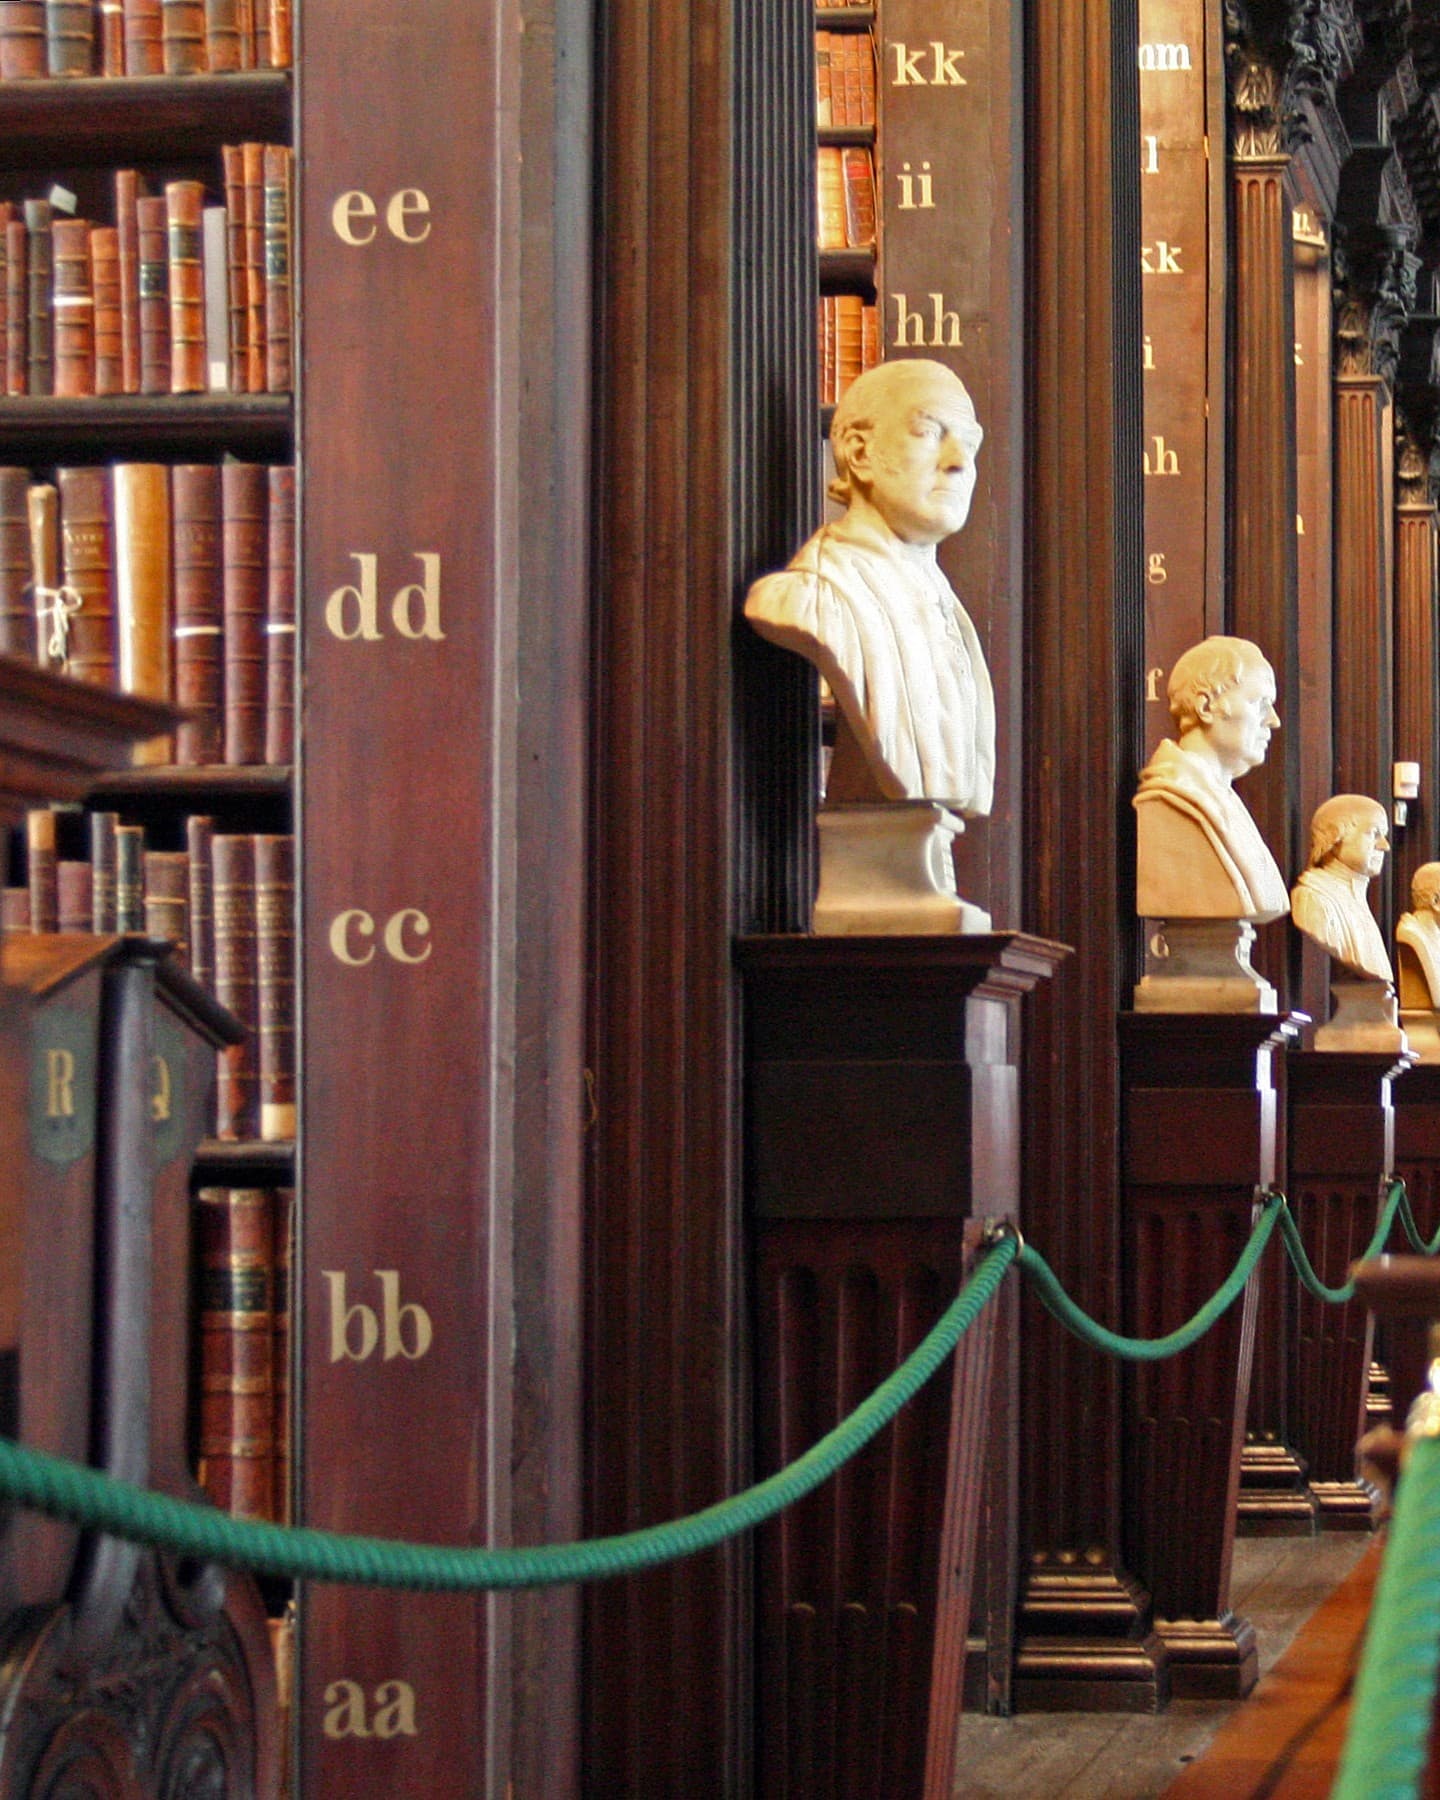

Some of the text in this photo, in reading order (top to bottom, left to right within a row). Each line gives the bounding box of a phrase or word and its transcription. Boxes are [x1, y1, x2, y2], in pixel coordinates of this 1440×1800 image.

[891, 41, 967, 86] kk
[896, 160, 936, 209] ii
[331, 188, 431, 246] ee
[891, 292, 963, 347] hh
[324, 552, 445, 641] dd
[328, 908, 432, 966] cc
[48, 1050, 75, 1117] R
[321, 1269, 432, 1363] bb
[323, 1679, 418, 1739] aa
